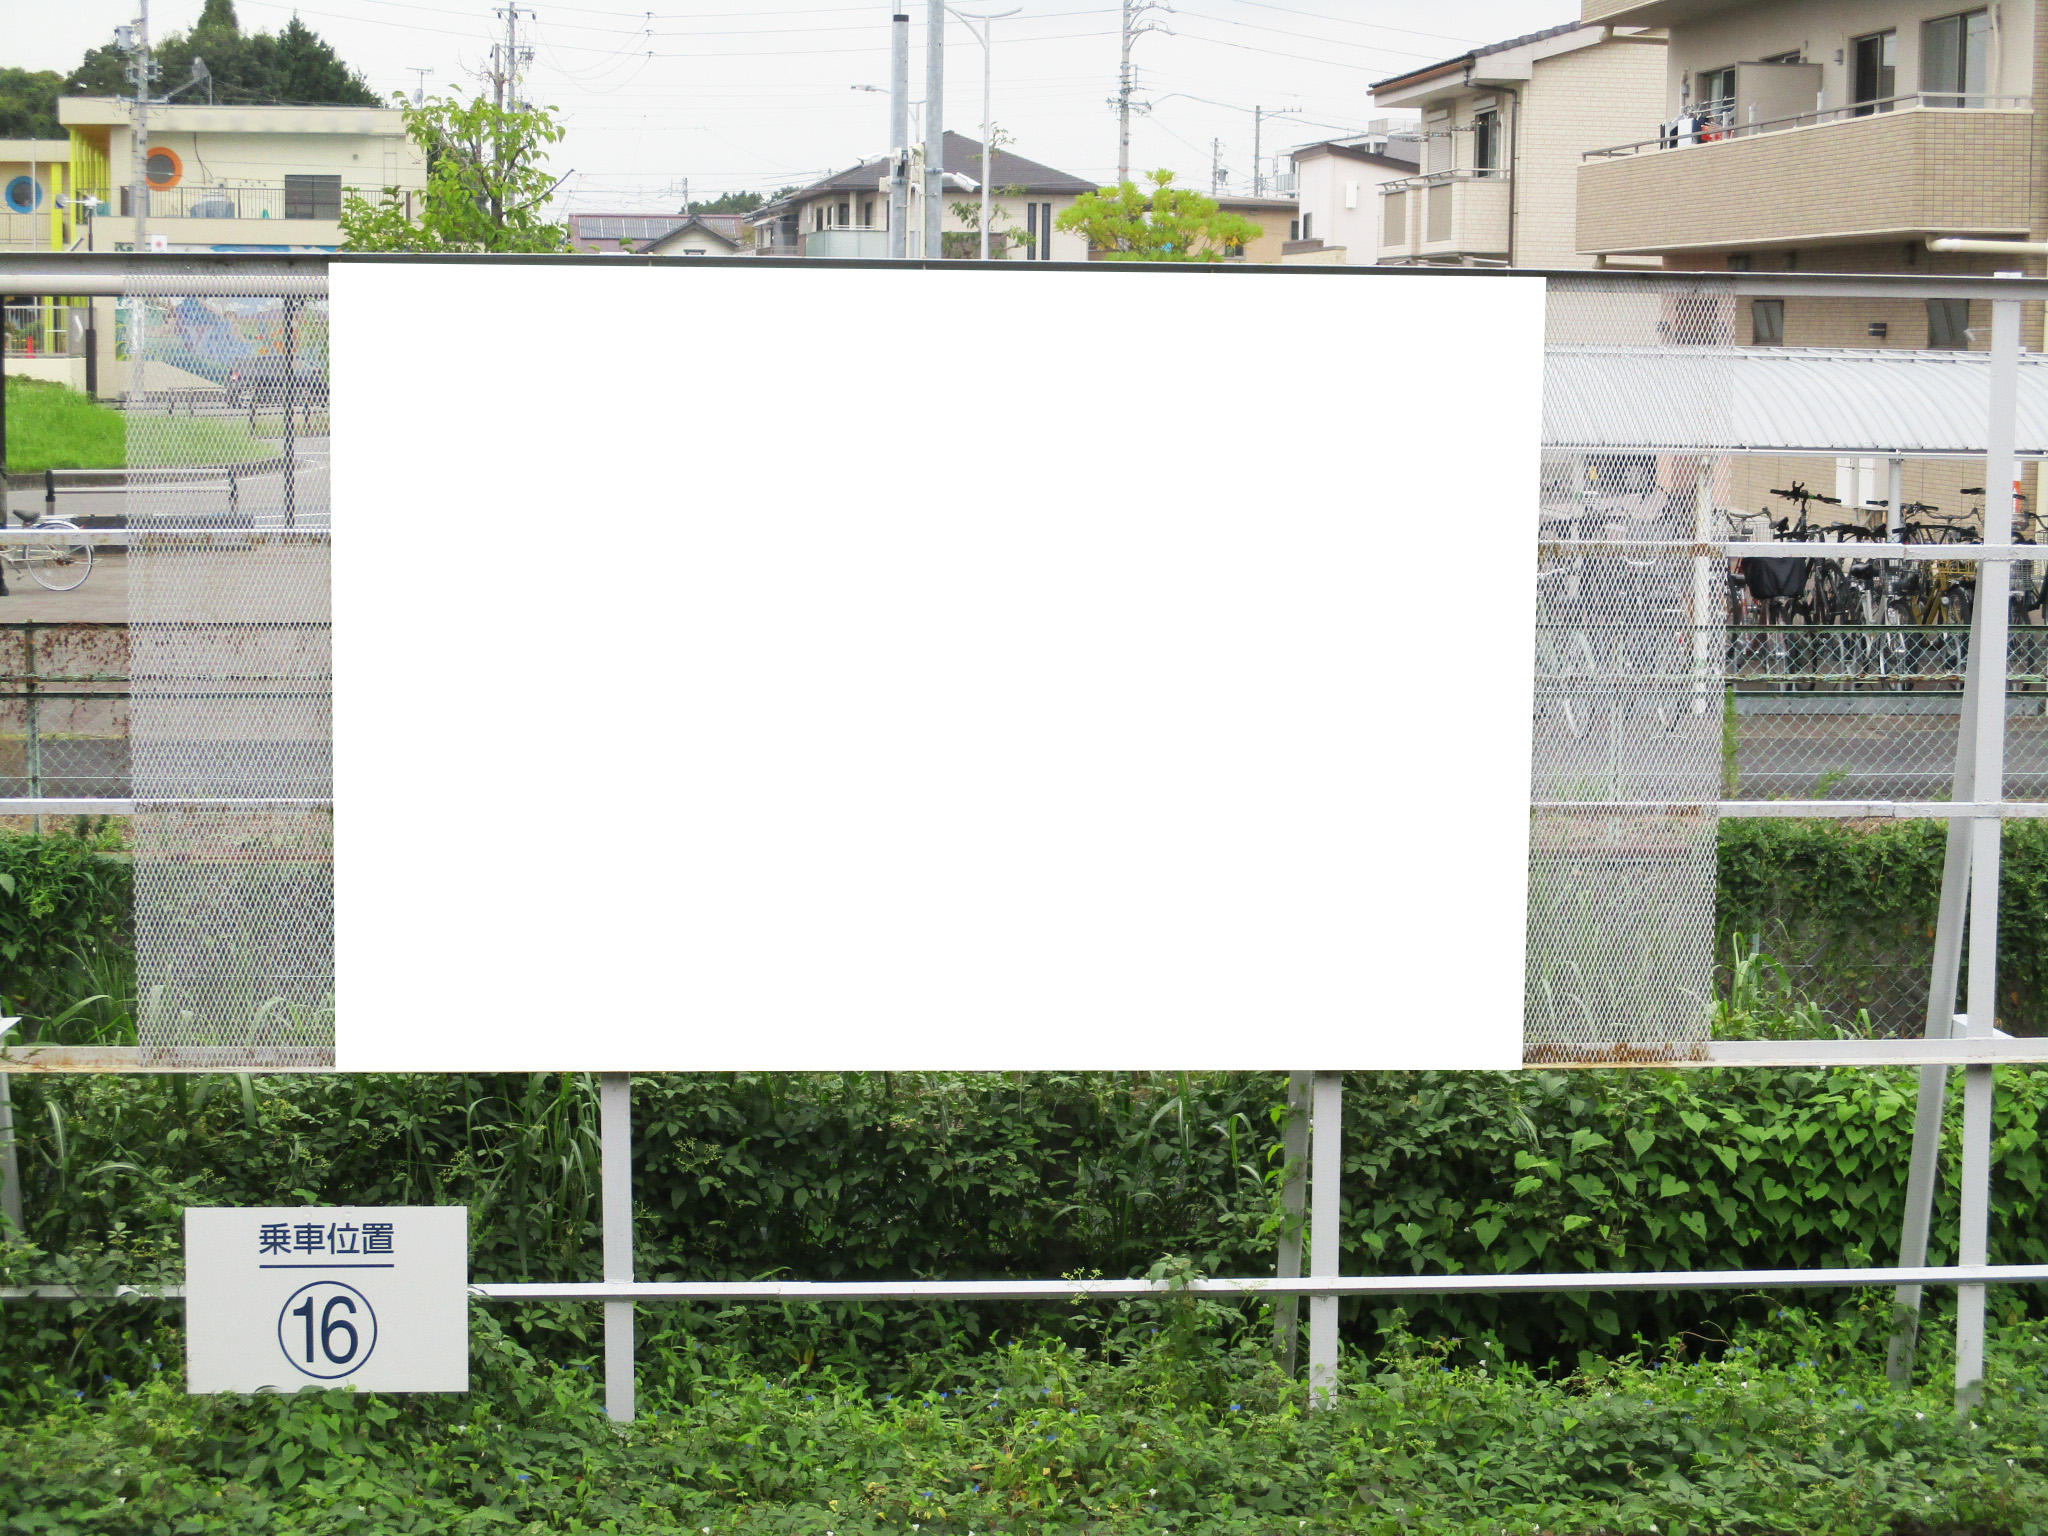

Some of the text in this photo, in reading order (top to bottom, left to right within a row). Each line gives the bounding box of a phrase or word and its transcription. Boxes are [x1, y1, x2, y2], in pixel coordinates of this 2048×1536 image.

[259, 1222, 395, 1255] 乗車位置
[293, 1295, 358, 1364] 16
